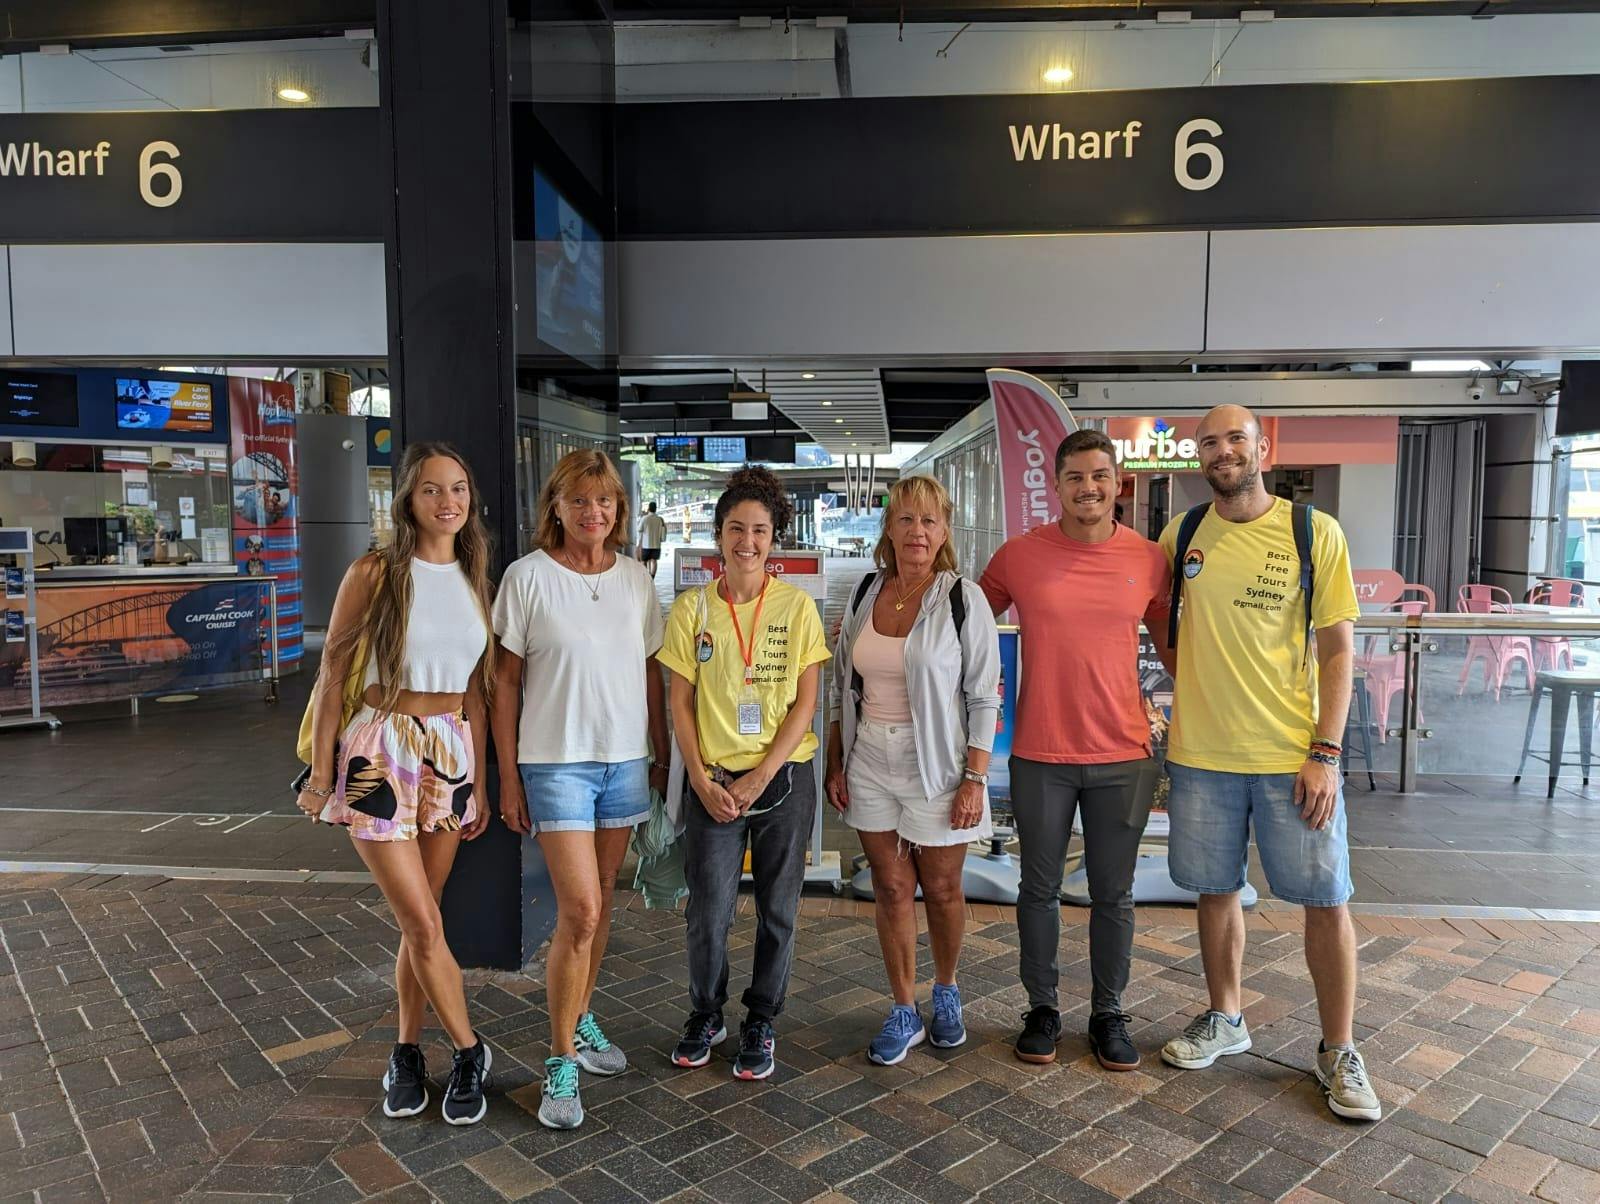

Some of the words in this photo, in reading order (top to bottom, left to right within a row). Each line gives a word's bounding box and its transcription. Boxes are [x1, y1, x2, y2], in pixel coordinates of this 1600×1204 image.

[1008, 120, 1142, 161] Wharf
[1174, 118, 1224, 191] 6
[0, 141, 111, 176] Wharf
[139, 140, 183, 208] 6
[1110, 430, 1199, 465] gurbe
[1124, 461, 1157, 469] PREMIUM
[1158, 461, 1188, 469] FROZEN
[1189, 461, 1200, 469] YO
[1017, 429, 1052, 526] yogur
[34, 530, 63, 545] CA
[1266, 551, 1291, 562] Best
[765, 562, 785, 573] ea
[1265, 563, 1289, 574] Free
[1256, 575, 1287, 587] Tours
[1246, 587, 1285, 602] Sydney
[1233, 599, 1282, 611] @gmail.com
[185, 612, 227, 623] CAPTAIN
[228, 610, 255, 620] COOK
[206, 621, 236, 630] CRUISES
[768, 625, 788, 633] Best
[768, 638, 788, 646] Free
[762, 650, 788, 659] Tours
[755, 663, 787, 673] Sydney
[1139, 659, 1165, 670] Pas
[751, 676, 788, 684] gmail.com
